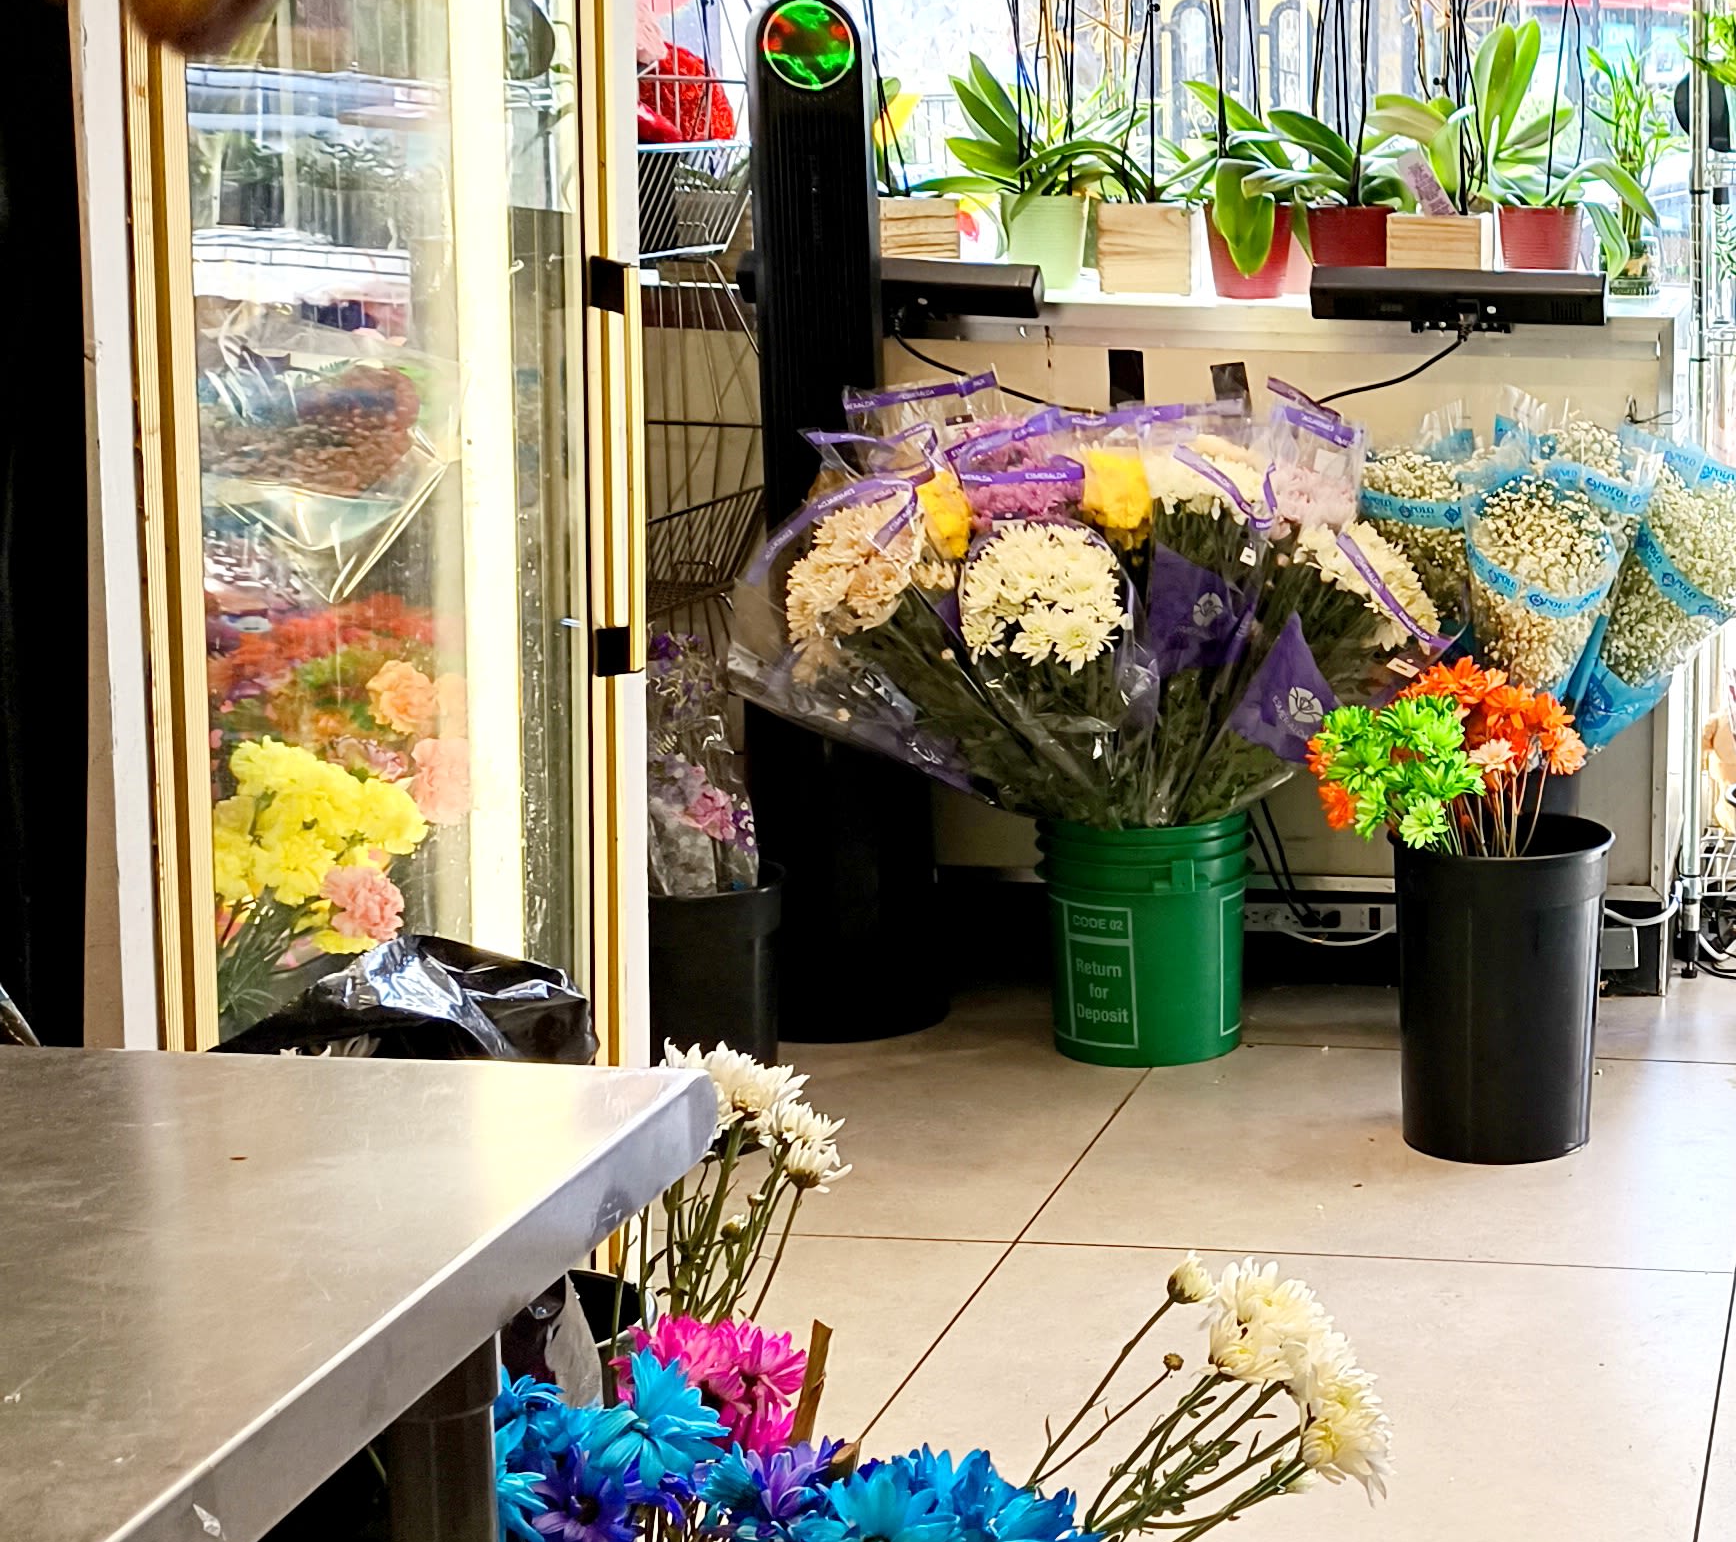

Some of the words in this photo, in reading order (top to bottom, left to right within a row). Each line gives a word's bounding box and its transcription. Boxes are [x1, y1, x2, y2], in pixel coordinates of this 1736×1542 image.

[1025, 471, 1068, 480] ESMERALDA
[1398, 610, 1431, 641] ESMERALDA
[1072, 914, 1107, 930] CODE
[1109, 918, 1124, 932] 02
[1075, 957, 1123, 979] Return
[1089, 982, 1109, 1000] for
[1076, 1002, 1129, 1024] Deposit
